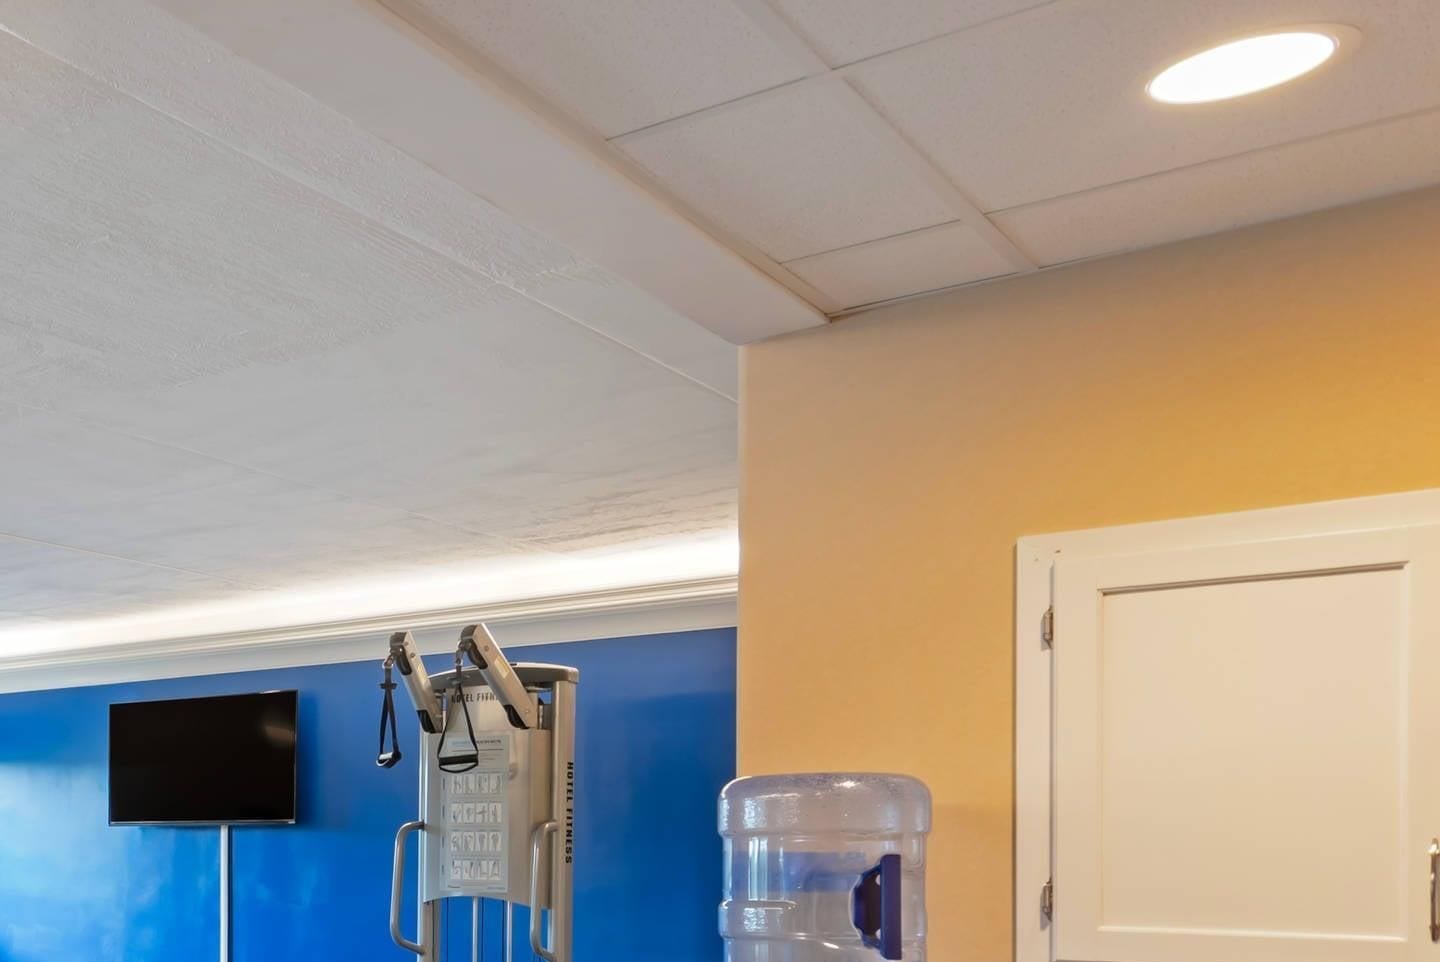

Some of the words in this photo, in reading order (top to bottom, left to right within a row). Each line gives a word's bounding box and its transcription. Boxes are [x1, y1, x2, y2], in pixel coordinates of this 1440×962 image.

[451, 694, 474, 703] HOEL
[566, 761, 574, 803] HOTEL
[565, 808, 573, 864] FITNESS
